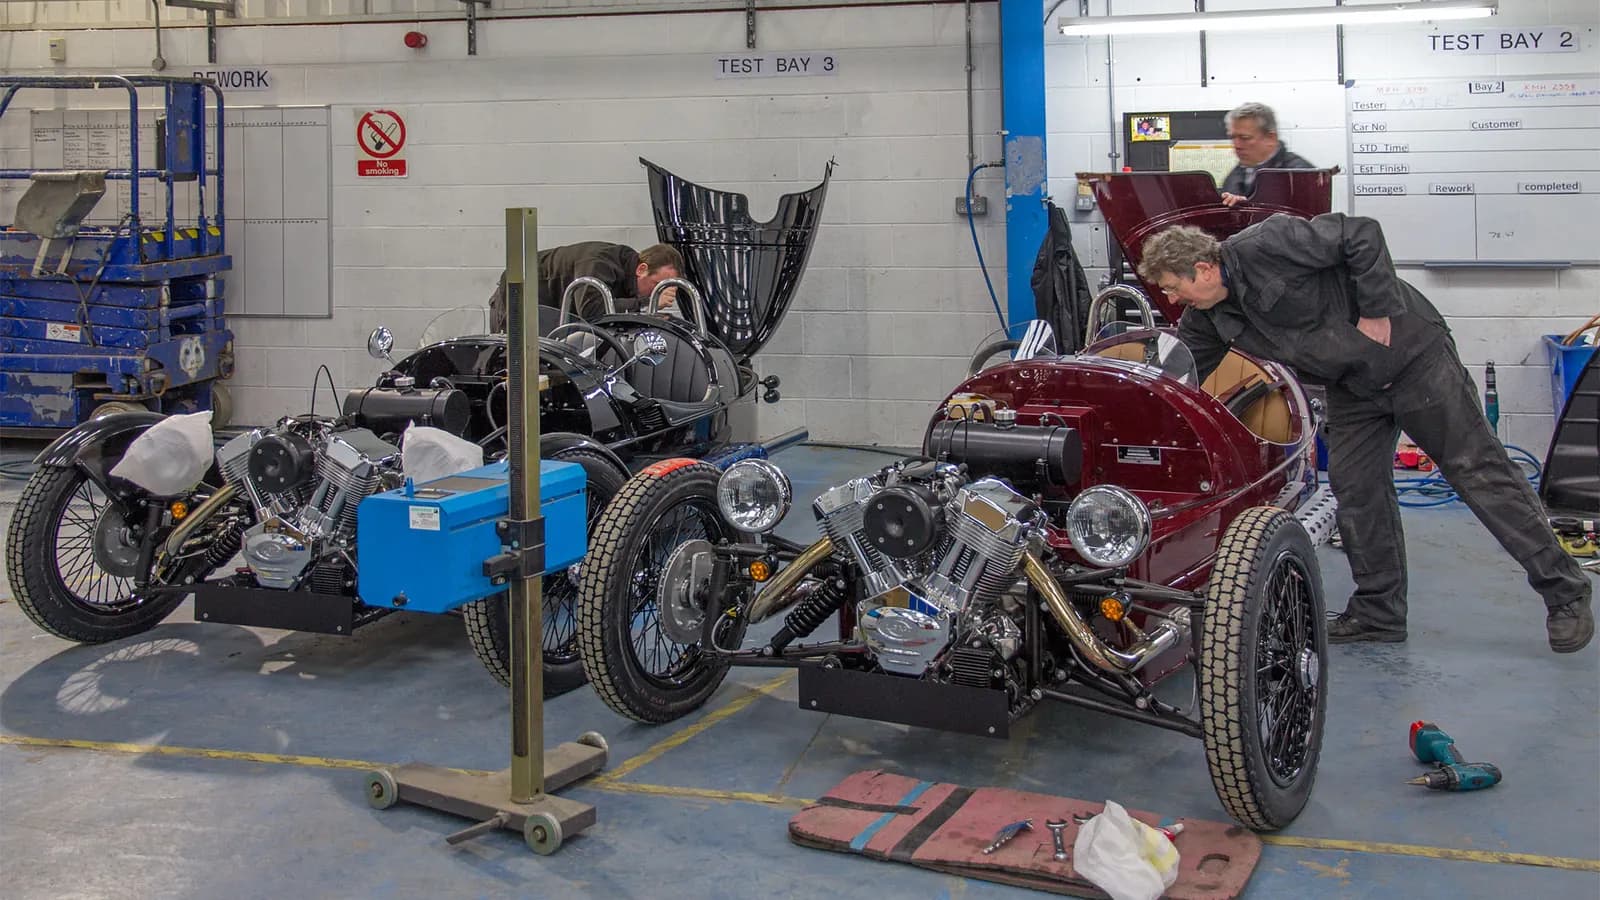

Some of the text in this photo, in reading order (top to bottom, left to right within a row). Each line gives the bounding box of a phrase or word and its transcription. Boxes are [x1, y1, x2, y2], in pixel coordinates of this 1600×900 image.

[1428, 31, 1573, 50] TEST BAY 2
[718, 56, 834, 73] TEST BAY 3
[1474, 81, 1501, 92] Bay 2
[1355, 101, 1384, 110] Tester
[1353, 123, 1385, 132] Car No
[1471, 120, 1519, 130] Customer
[1359, 143, 1408, 152] STD Time
[365, 168, 399, 176] smoking
[1359, 163, 1408, 173] Est Finish
[1356, 184, 1404, 195] Shortages
[1435, 183, 1472, 193] Rework
[1524, 181, 1579, 193] completed
